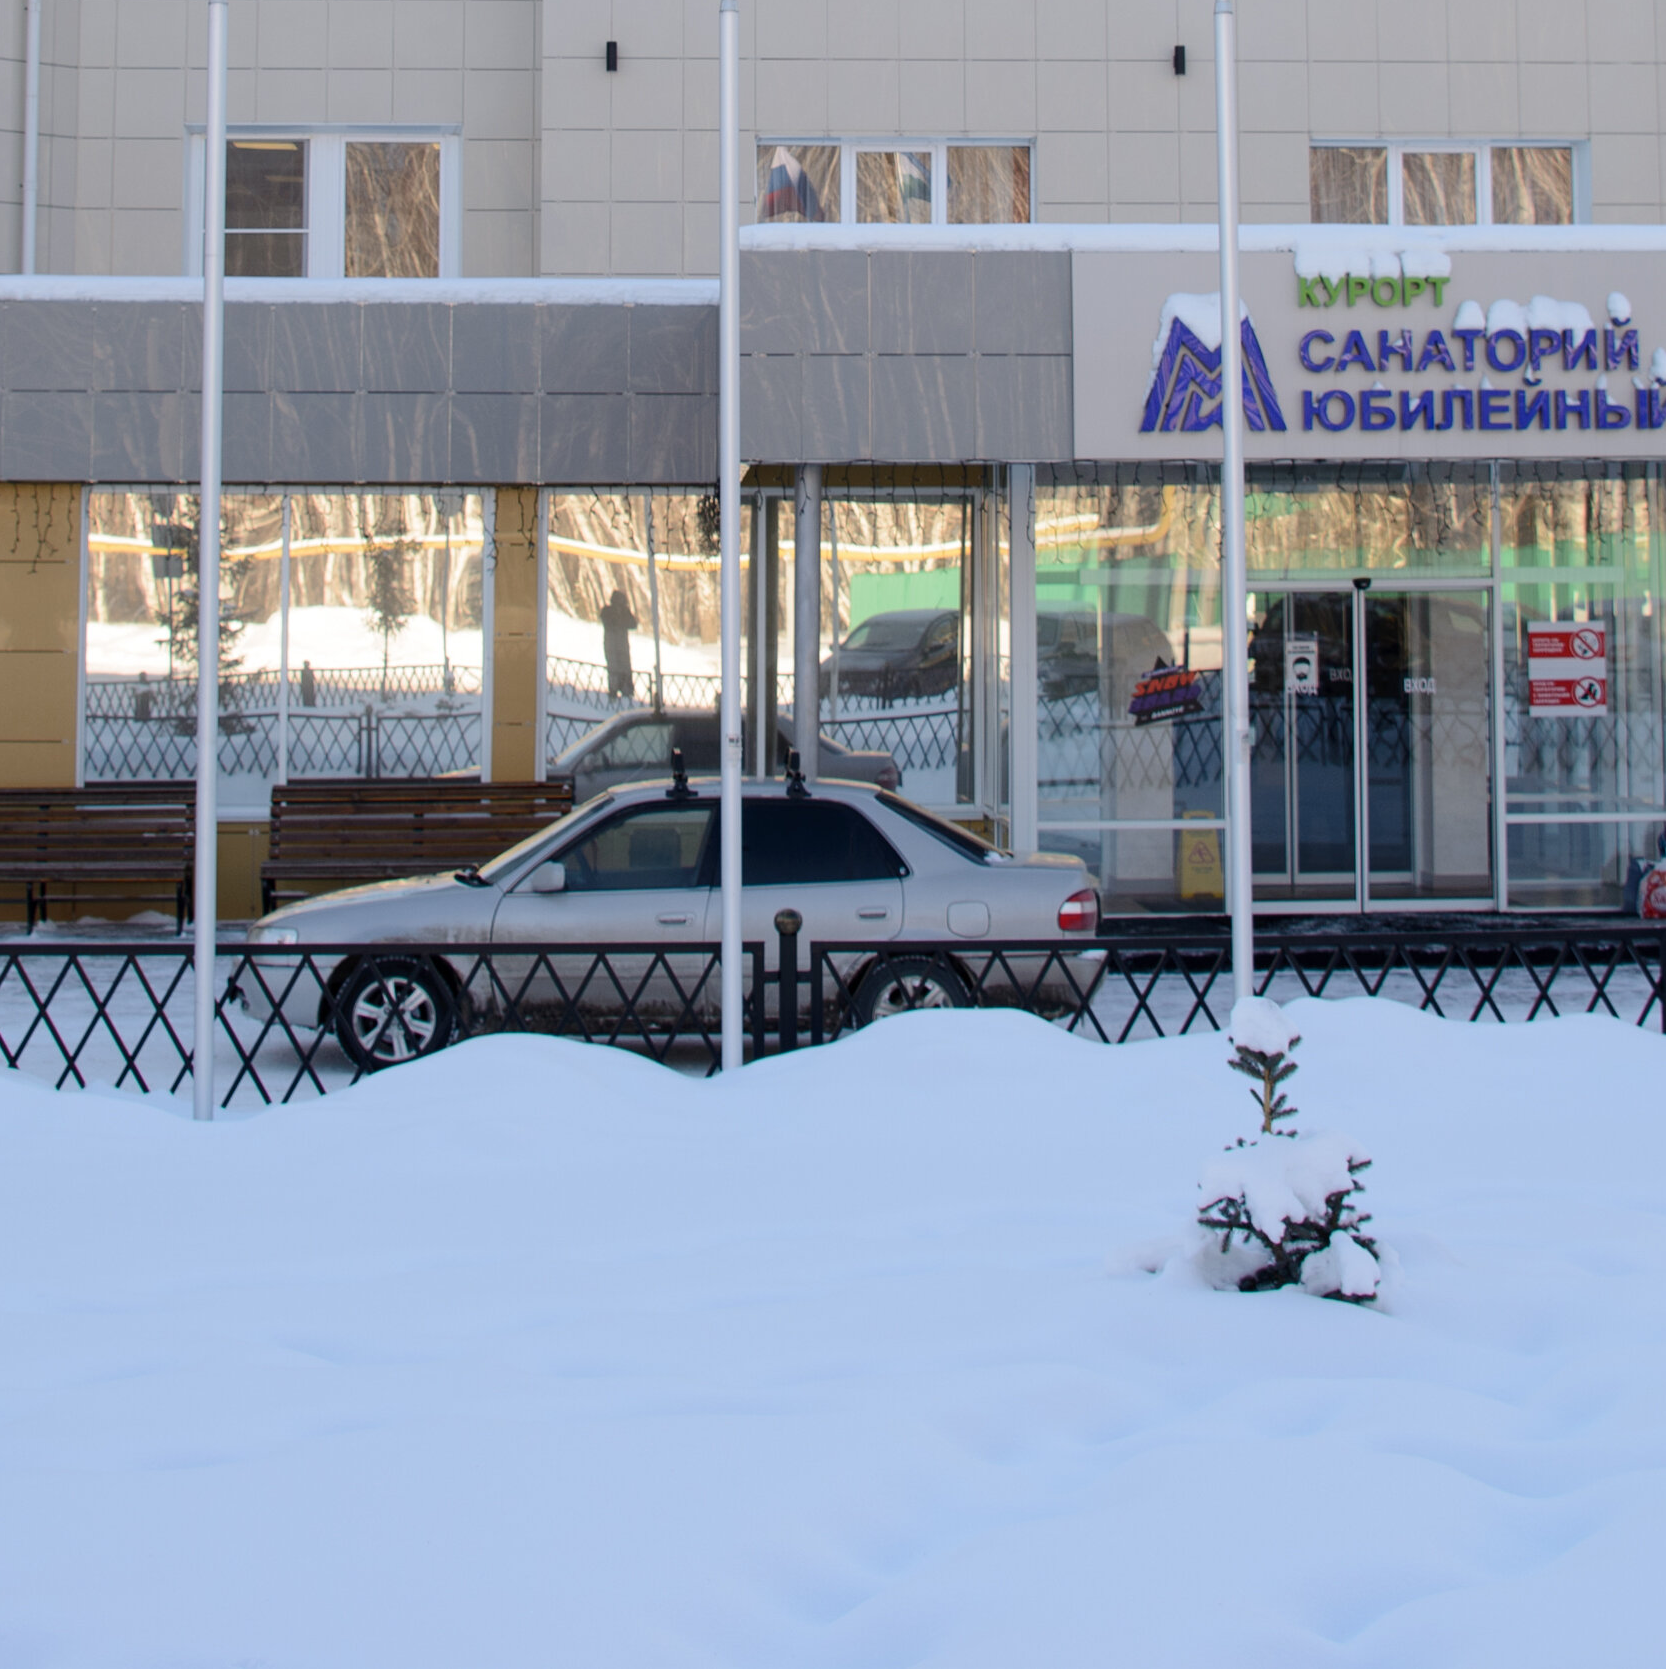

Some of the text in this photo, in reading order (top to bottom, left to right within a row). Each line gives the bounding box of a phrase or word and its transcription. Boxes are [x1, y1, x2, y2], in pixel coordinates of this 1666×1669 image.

[1298, 275, 1450, 308] КУРОРТ
[1299, 316, 1640, 372] САНАТОРИЙ
[1330, 667, 1353, 682] ВХО
[1404, 678, 1437, 695] ВХОД
